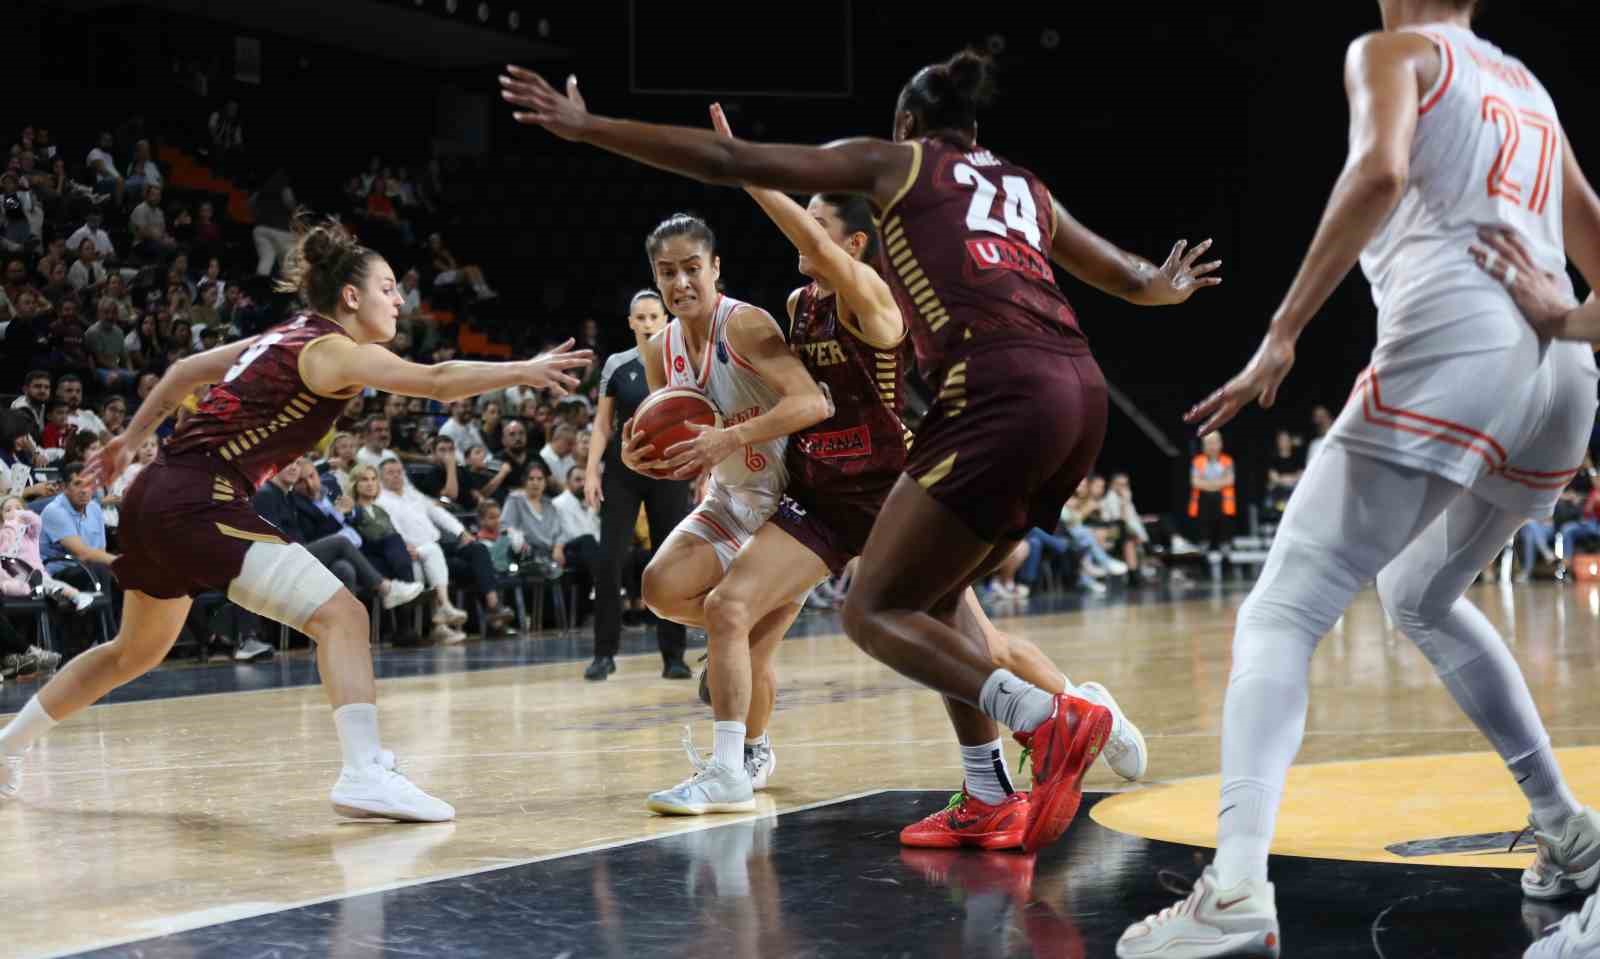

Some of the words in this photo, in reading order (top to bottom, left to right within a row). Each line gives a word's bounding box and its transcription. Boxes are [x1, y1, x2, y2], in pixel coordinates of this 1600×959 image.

[1481, 95, 1556, 216] 27
[953, 162, 1041, 252] 24
[745, 443, 767, 472] 6
